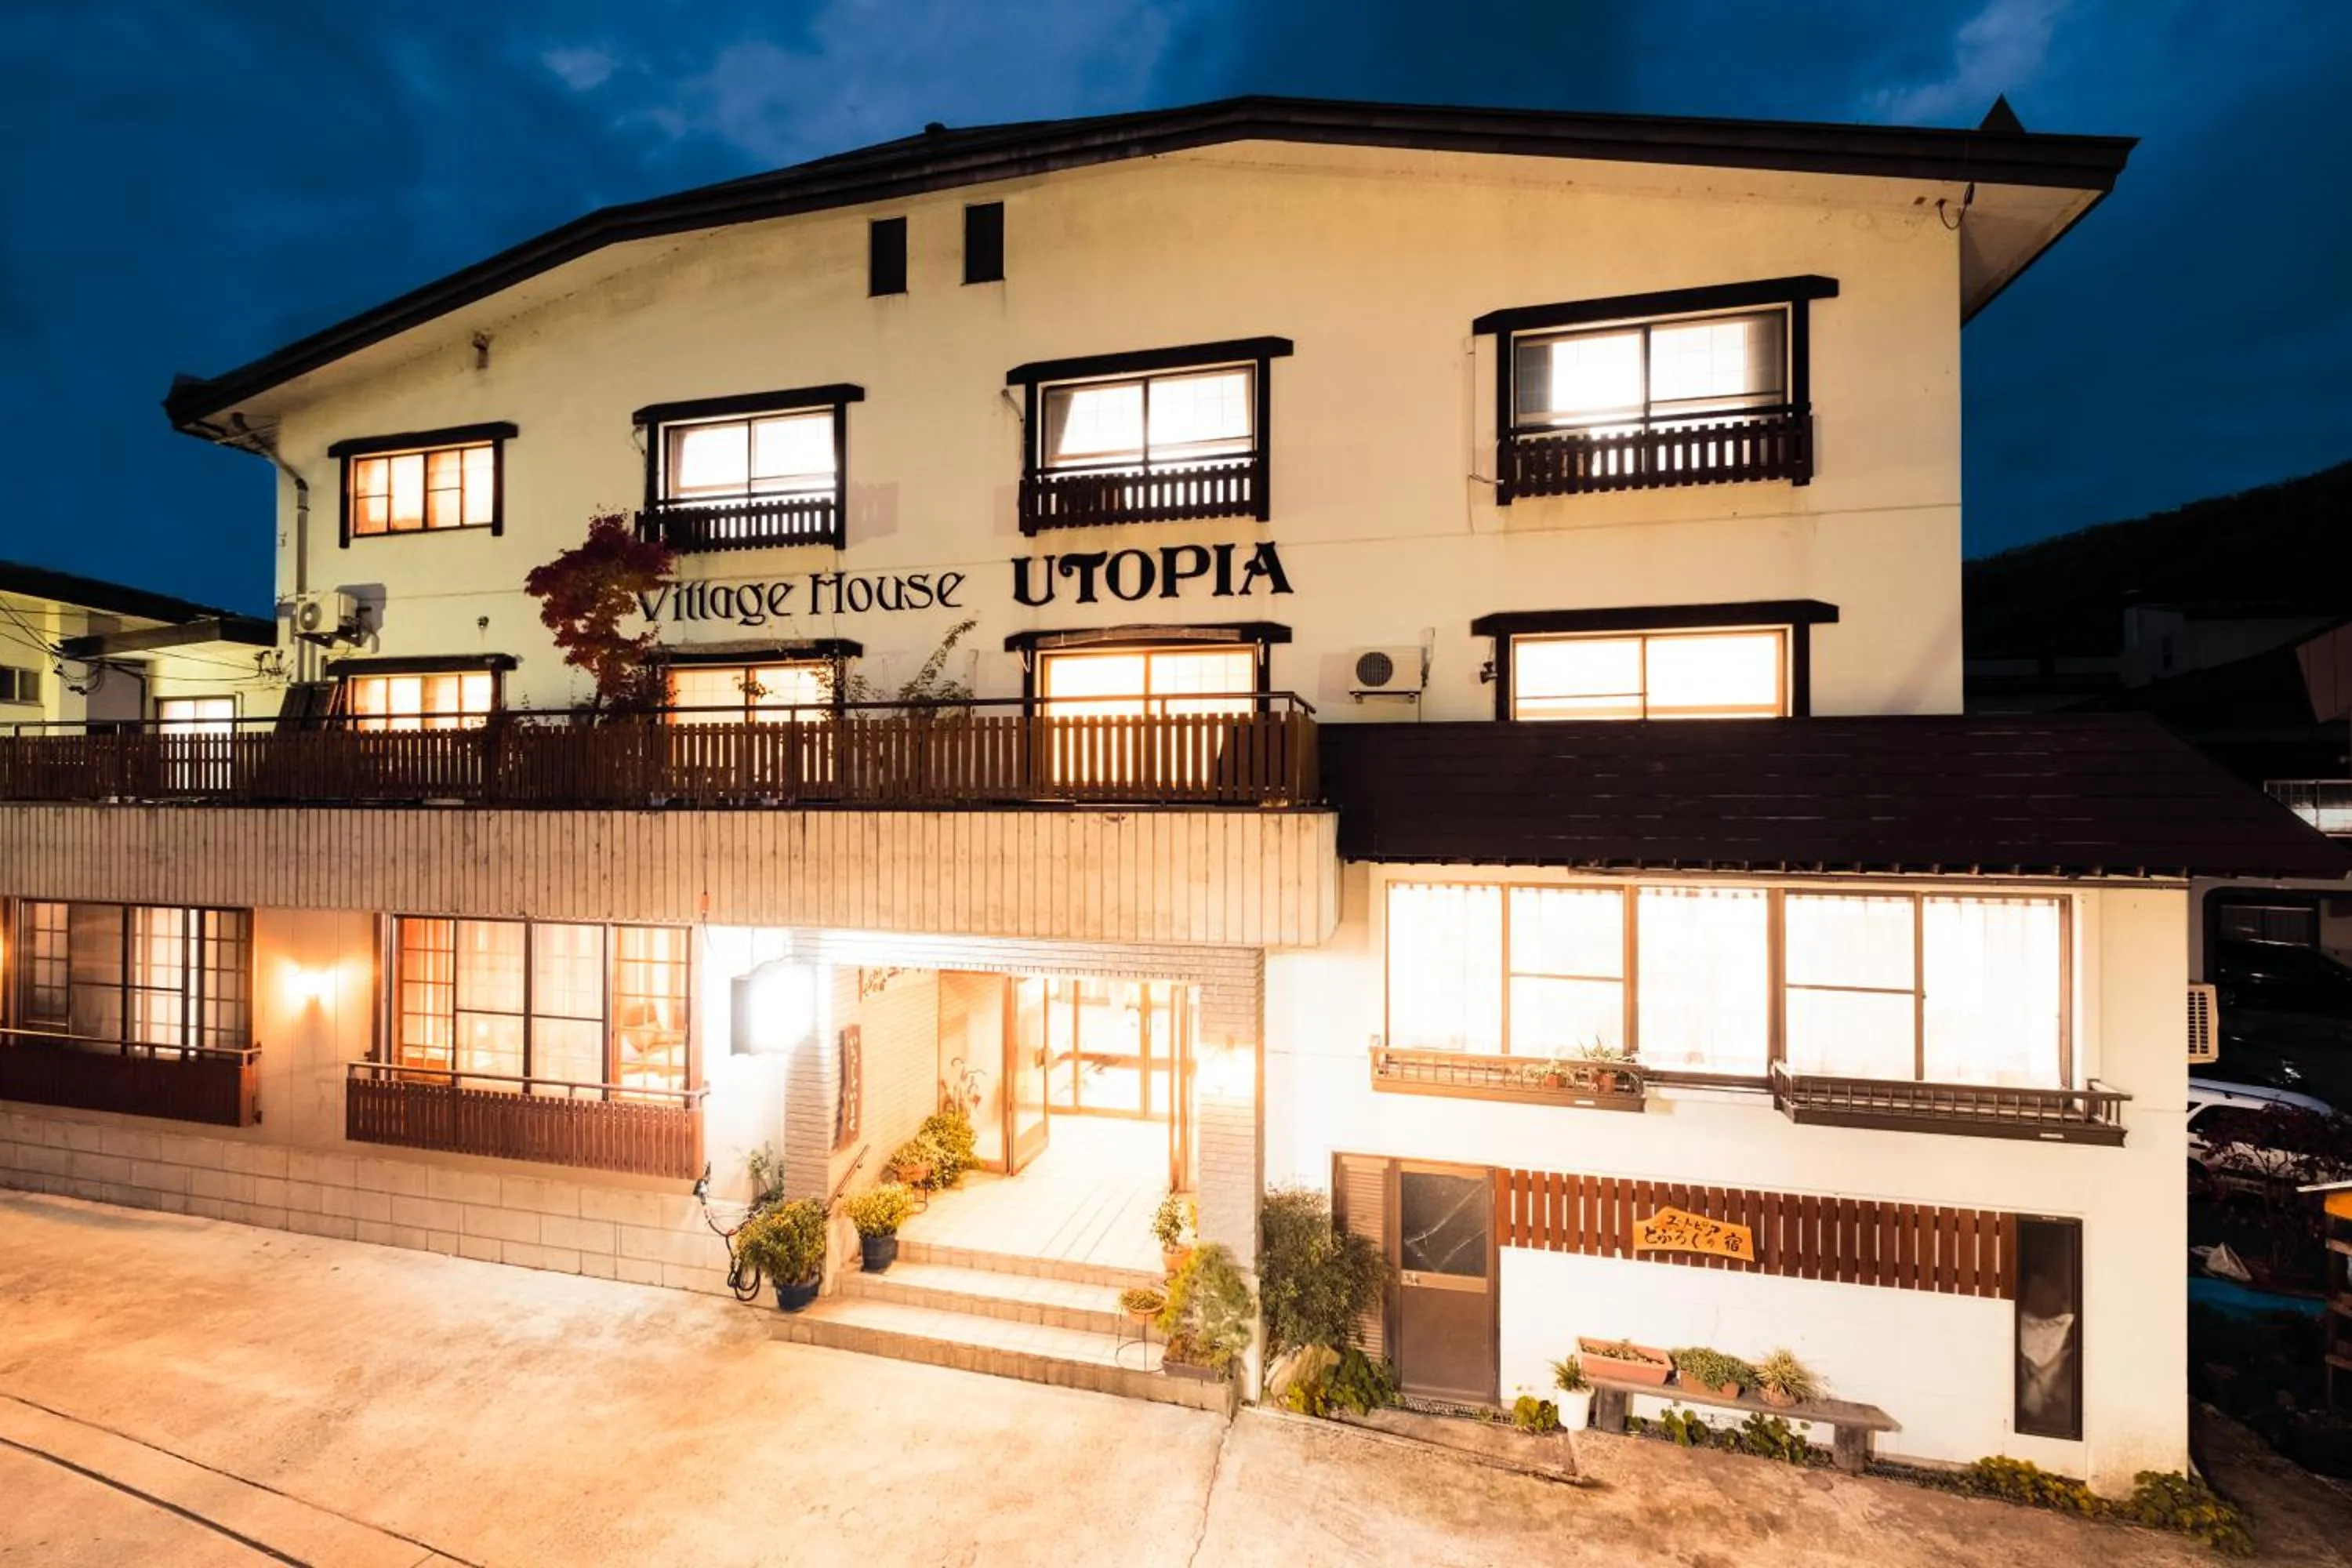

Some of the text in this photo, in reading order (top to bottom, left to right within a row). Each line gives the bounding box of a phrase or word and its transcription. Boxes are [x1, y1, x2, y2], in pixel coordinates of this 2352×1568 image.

[637, 541, 1294, 626] Village House UTOPIA
